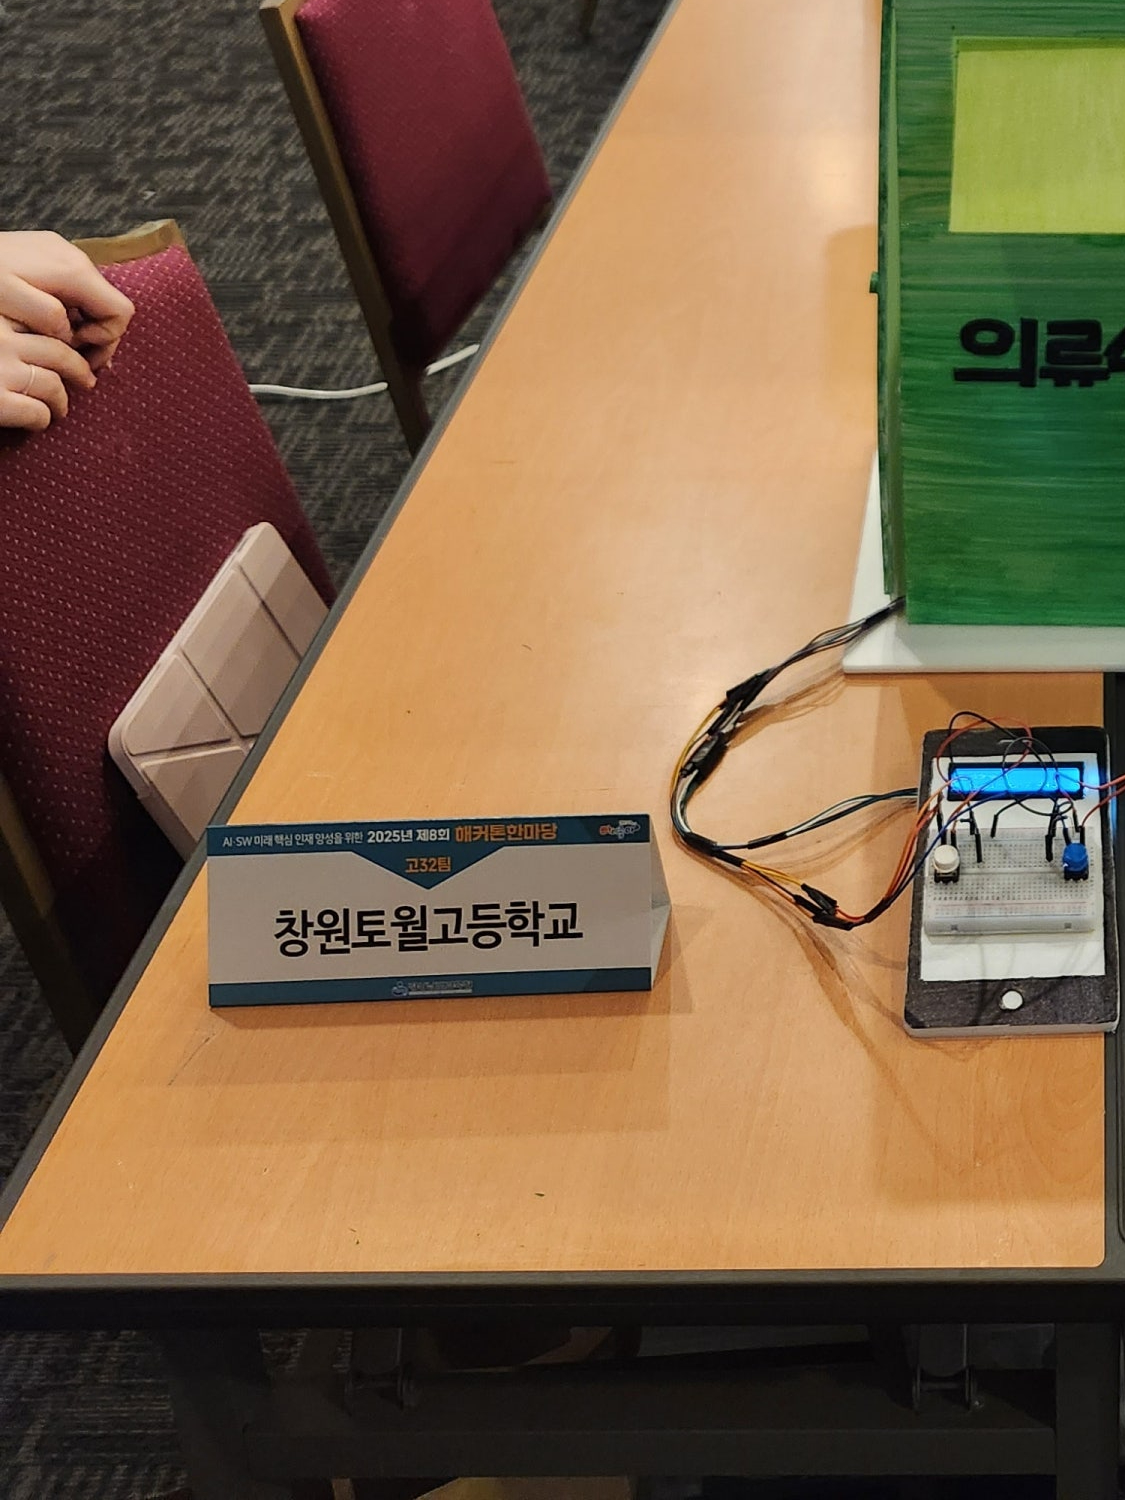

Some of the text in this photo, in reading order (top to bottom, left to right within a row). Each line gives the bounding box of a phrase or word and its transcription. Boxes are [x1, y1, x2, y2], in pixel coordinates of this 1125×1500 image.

[253, 834, 273, 847] 미래
[274, 833, 293, 846] 핵심
[294, 833, 314, 846] 인재
[314, 831, 343, 845] 양성을
[344, 830, 364, 844] 위한
[367, 829, 413, 844] 2025년
[416, 827, 450, 842] 제8회
[405, 856, 451, 874] 고32팀
[273, 900, 585, 960] 창원토월고등학교
